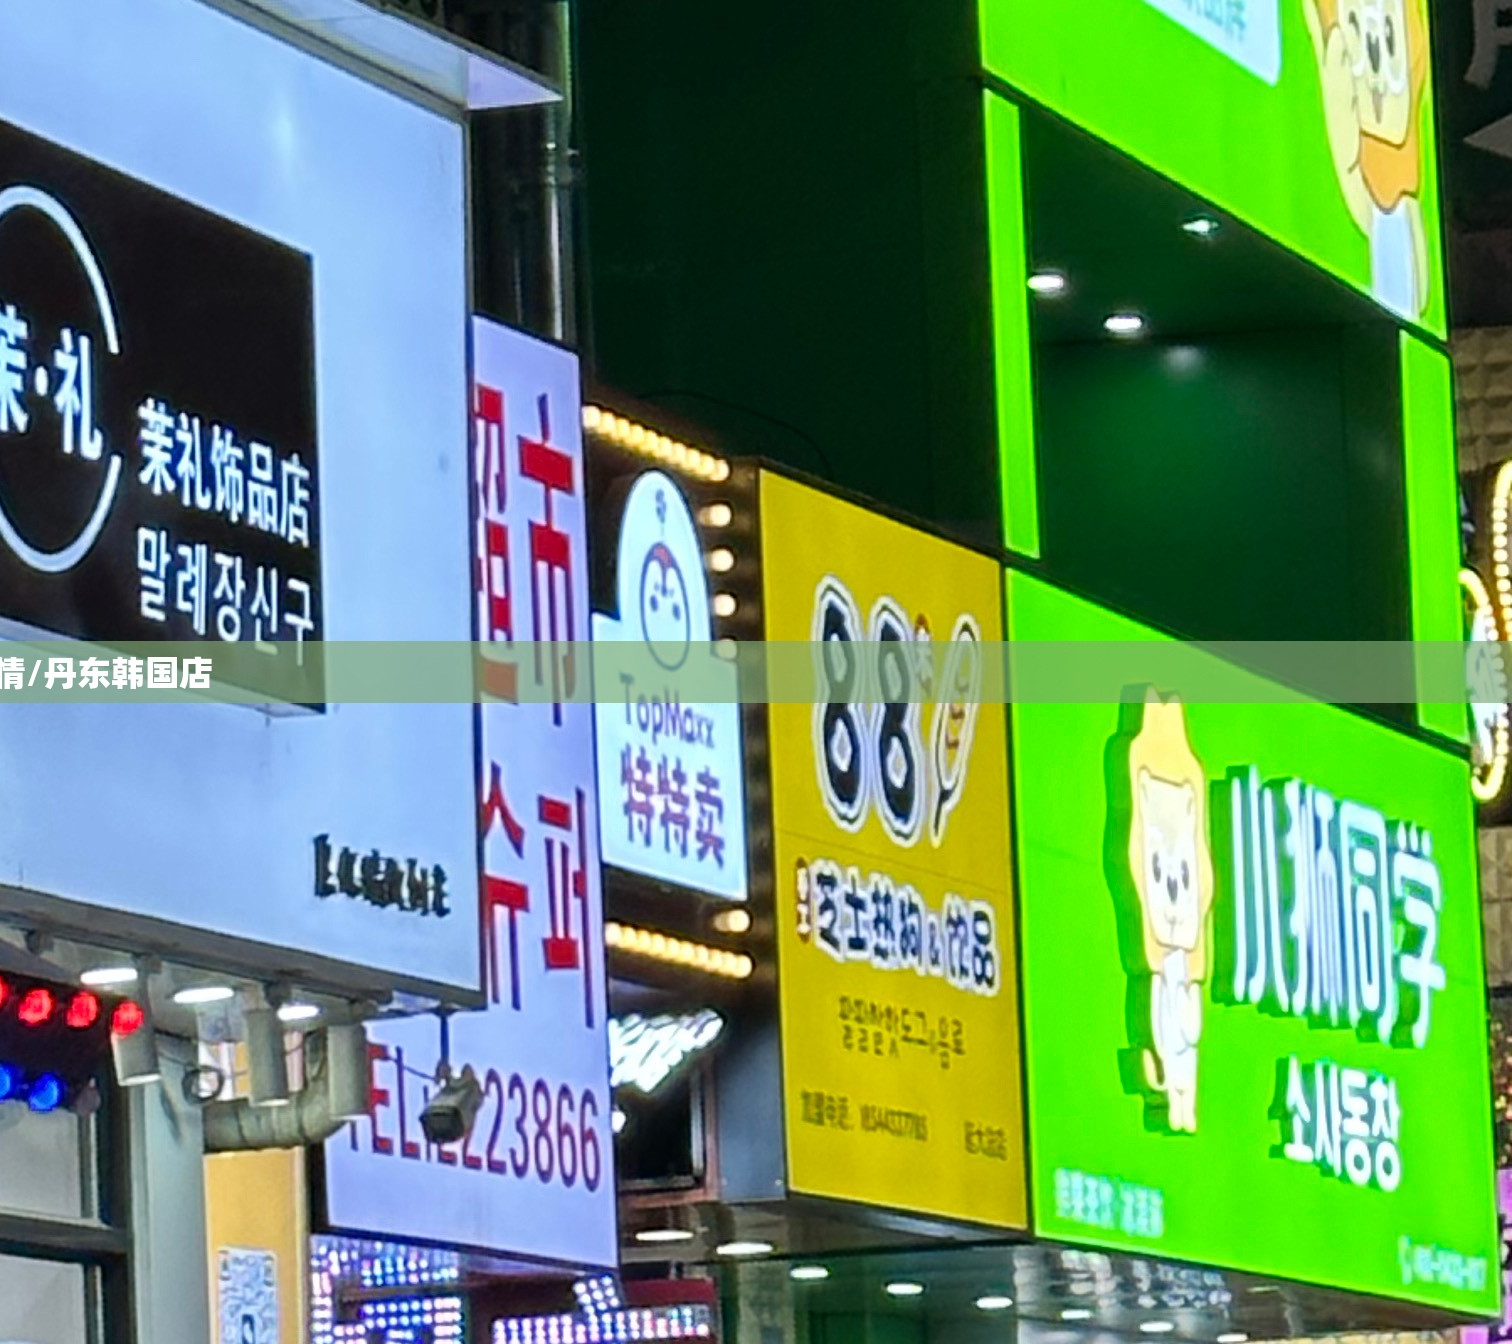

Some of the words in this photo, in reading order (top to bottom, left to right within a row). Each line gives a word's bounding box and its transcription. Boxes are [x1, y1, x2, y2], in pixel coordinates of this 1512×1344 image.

[619, 672, 717, 749] TopMaxx
[620, 744, 726, 870] 特特卖
[1230, 764, 1448, 1050] 小狮同学
